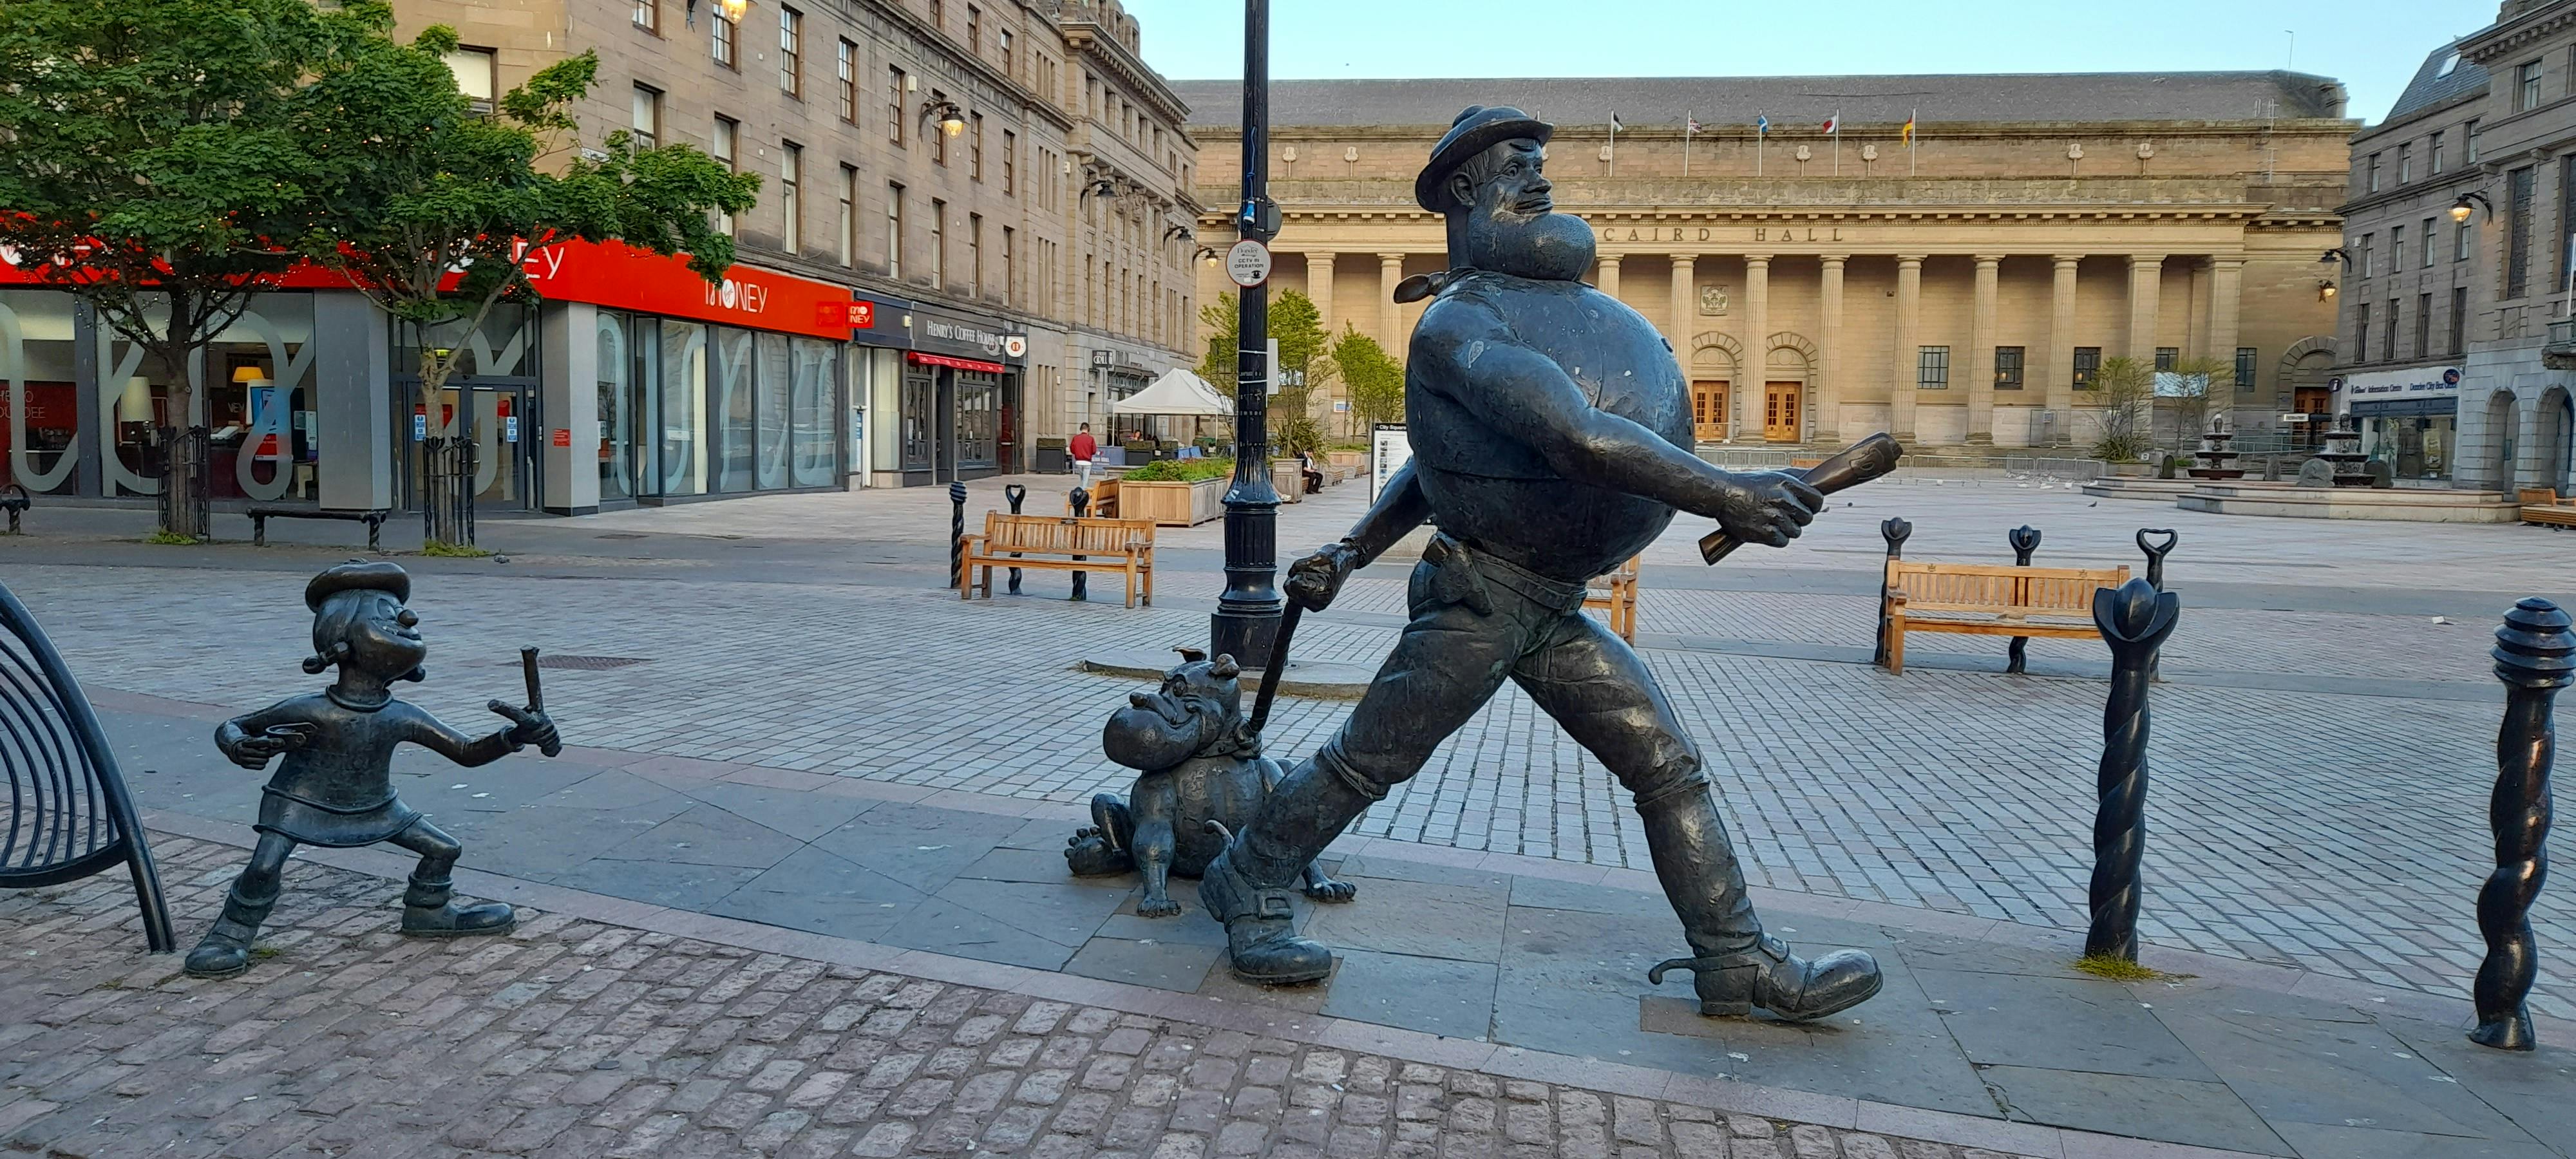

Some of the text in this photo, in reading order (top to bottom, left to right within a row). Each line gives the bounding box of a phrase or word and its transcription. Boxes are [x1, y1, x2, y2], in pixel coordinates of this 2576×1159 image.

[1604, 228, 1843, 241] CAIRD HALL
[850, 315, 871, 324] NEY
[927, 320, 953, 339] HENRY'S
[954, 325, 976, 343] COFFEE
[0, 390, 33, 403] HEO
[0, 406, 46, 419] DUDEE
